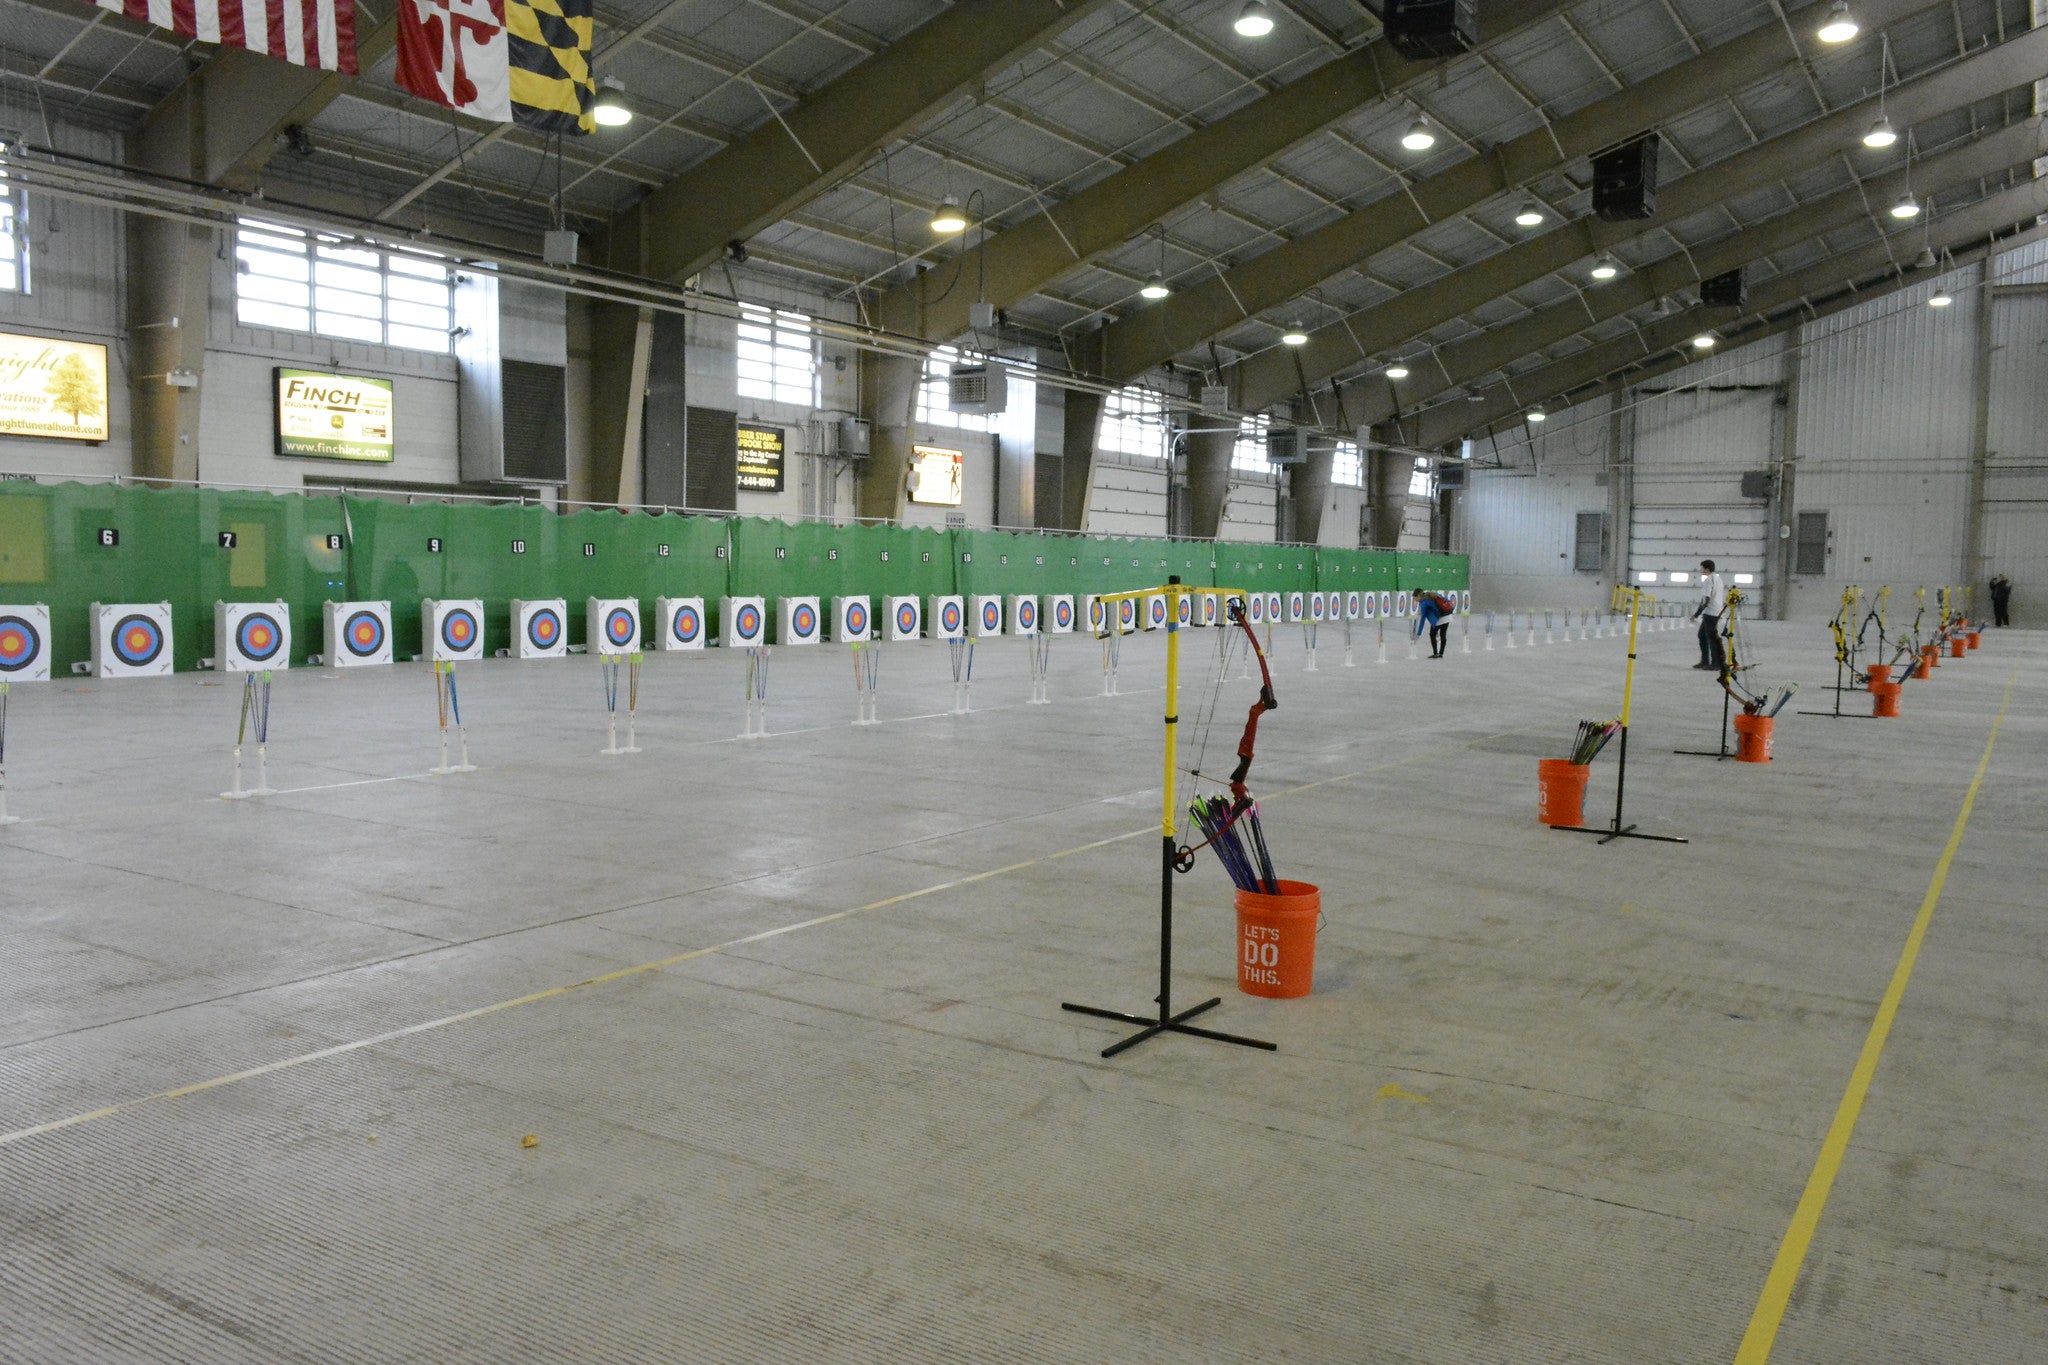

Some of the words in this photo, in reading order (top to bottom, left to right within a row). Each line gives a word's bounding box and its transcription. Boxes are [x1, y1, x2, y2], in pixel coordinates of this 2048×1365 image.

[286, 380, 361, 406] FINCH
[755, 431, 777, 442] STAMP
[285, 442, 389, 458] www.finchinc.com
[103, 530, 113, 545] 6
[223, 533, 232, 547] 7
[331, 535, 339, 549] 8
[431, 539, 439, 552] 9
[513, 541, 525, 553] 10
[585, 544, 593, 556] 11
[659, 545, 669, 556] 12
[716, 546, 725, 558] 13
[776, 548, 785, 558] 14
[829, 550, 837, 560] 15
[881, 551, 889, 561] 16
[923, 552, 930, 562] 17
[964, 553, 971, 562] 18
[1244, 924, 1280, 941] LET'S
[1244, 938, 1279, 967] DO
[1244, 965, 1281, 985] THIS.
